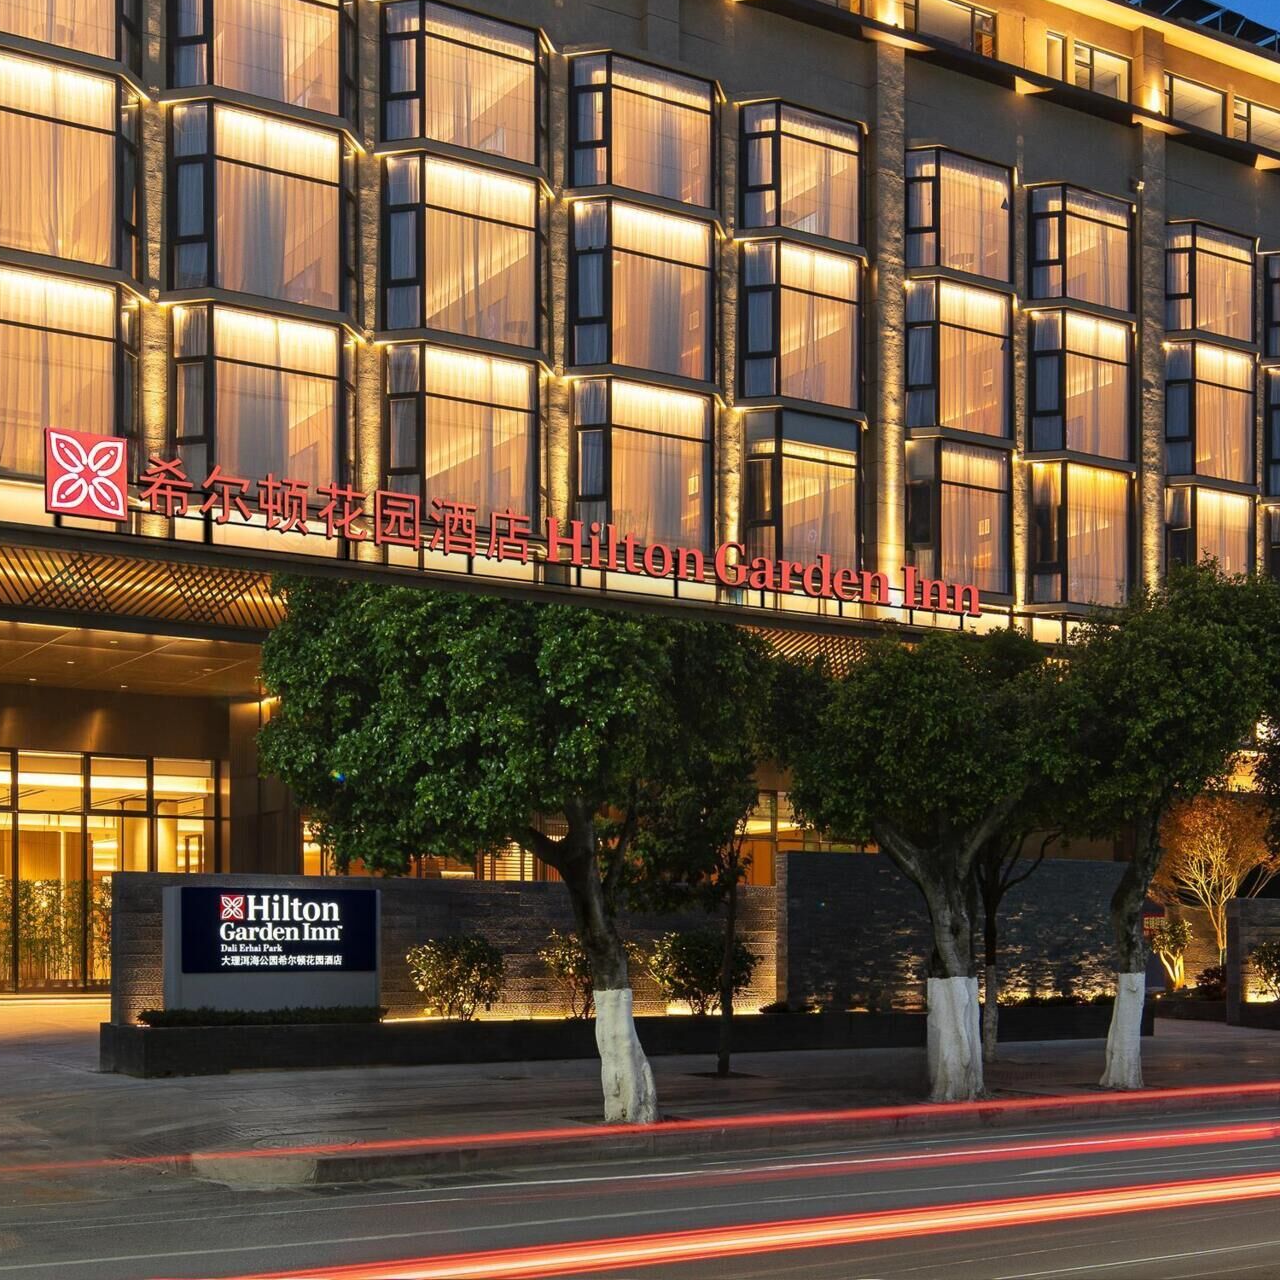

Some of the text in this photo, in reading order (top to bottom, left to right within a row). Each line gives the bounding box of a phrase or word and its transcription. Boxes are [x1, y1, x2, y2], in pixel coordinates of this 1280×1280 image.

[139, 458, 982, 617] 希尔顿花园酒店 Hilton Garden Inn
[247, 894, 340, 922] Hilton
[220, 922, 299, 941] Garden
[220, 944, 283, 953] Dali Erhai Park
